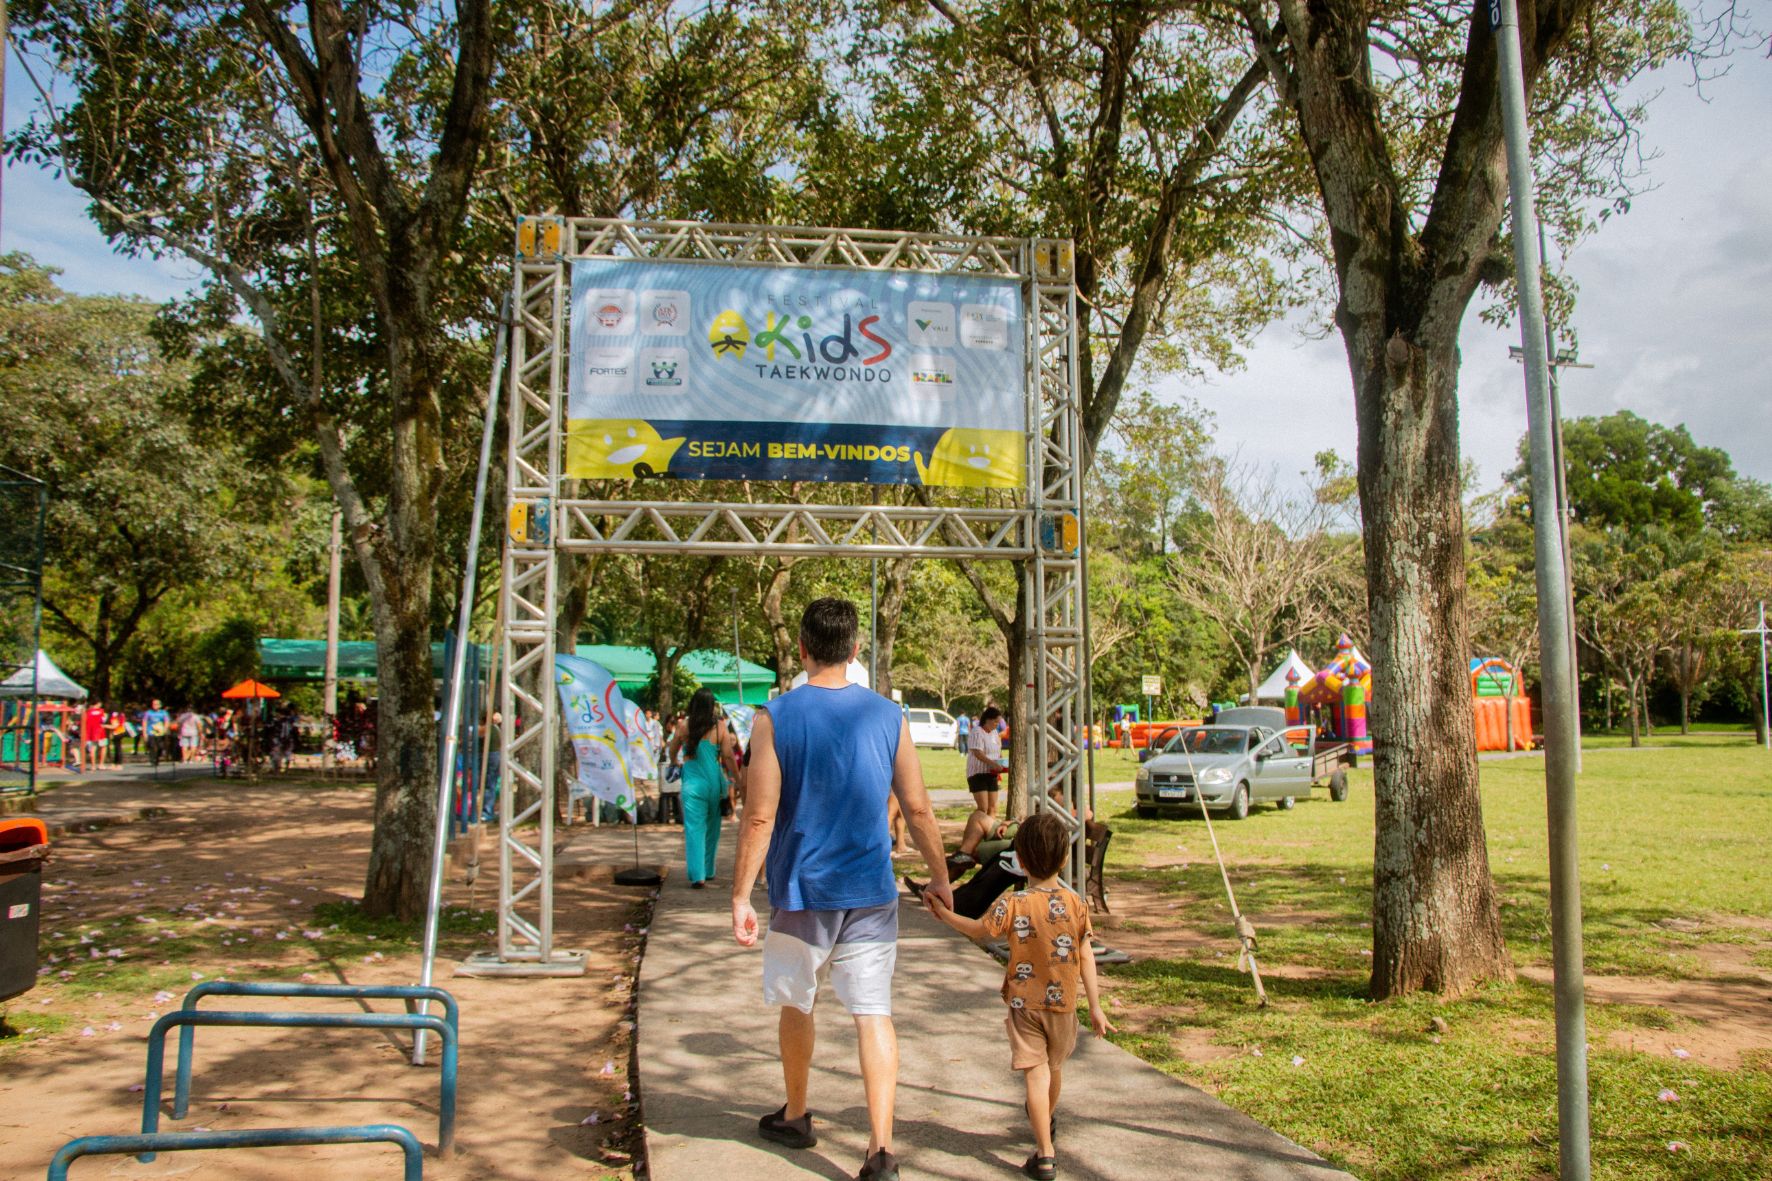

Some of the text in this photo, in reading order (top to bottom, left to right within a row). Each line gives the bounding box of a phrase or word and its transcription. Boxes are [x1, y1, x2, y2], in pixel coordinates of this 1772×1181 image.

[767, 294, 879, 309] FESTIVAL
[589, 367, 627, 376] FORTES
[755, 364, 892, 383] TAEKWONDO
[687, 441, 911, 463] SEJAM BEM-VINDOS
